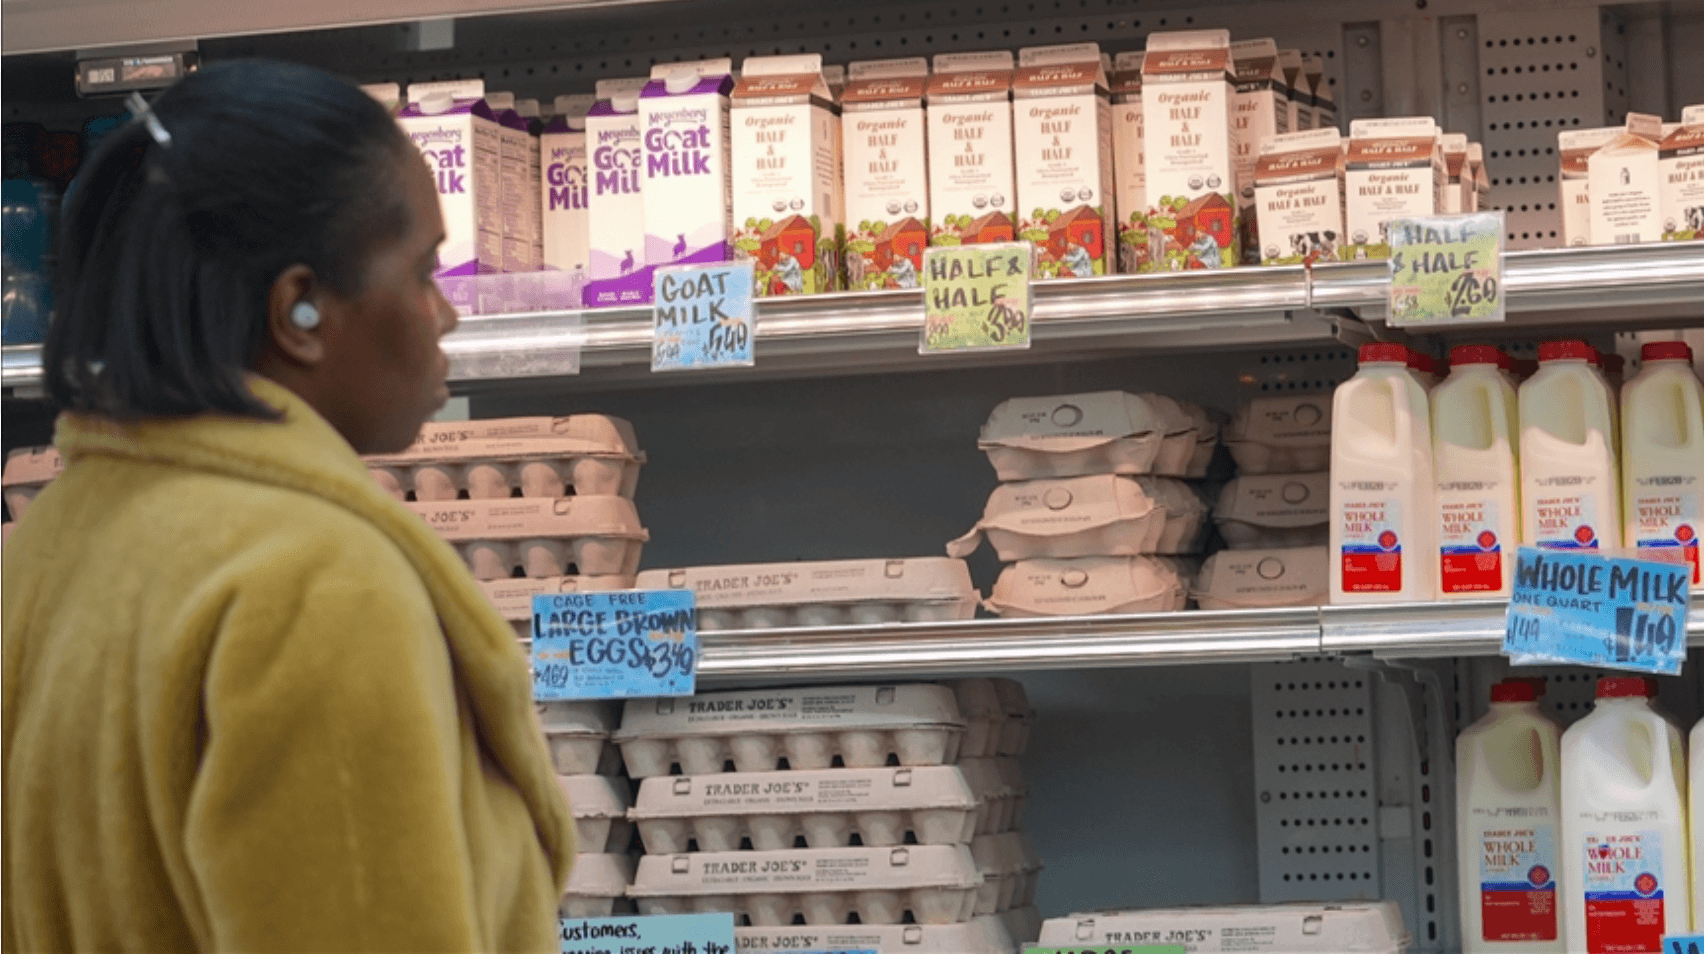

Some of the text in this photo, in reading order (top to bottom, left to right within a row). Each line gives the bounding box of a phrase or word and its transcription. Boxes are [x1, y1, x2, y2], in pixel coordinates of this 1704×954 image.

[1158, 89, 1211, 106] Organic
[943, 110, 994, 126] Organic
[1030, 103, 1081, 120] Organic
[1170, 106, 1202, 121] HALF
[745, 112, 796, 129] Organic
[858, 116, 908, 133] Organic
[1041, 120, 1072, 134] HALF
[1182, 121, 1190, 133] &
[645, 125, 710, 152] Goat
[756, 129, 786, 143] HALF
[868, 133, 898, 147] HALF
[954, 127, 985, 141] HALF
[1052, 134, 1061, 147] &
[1170, 133, 1202, 148] HALF
[879, 147, 887, 159] &
[965, 141, 974, 153] &
[1042, 147, 1073, 161] HALF
[593, 145, 641, 171] Goa
[647, 150, 711, 178] Milk
[756, 155, 787, 170] HALF
[954, 153, 985, 167] HALF
[547, 162, 588, 187] Go
[869, 160, 899, 174] HALF
[438, 170, 466, 194] lk
[596, 169, 641, 195] Mil
[1368, 172, 1410, 185] Organic
[1276, 185, 1316, 200] Organic
[1359, 182, 1421, 197] HALF & HALF
[549, 185, 588, 211] Mil
[1268, 194, 1328, 212] HALF & HALF
[1404, 224, 1477, 246] HALF
[930, 255, 1003, 281] HALF
[1412, 250, 1480, 274] HALF
[661, 270, 731, 303] GOAT
[932, 283, 1008, 310] HALF
[656, 297, 730, 328] MILK
[1343, 511, 1387, 521] WHOLE
[1441, 511, 1485, 522] WHOLE
[1537, 506, 1582, 518] WHOLE
[1639, 506, 1682, 516] WHOLE
[1343, 522, 1373, 533] MILK
[1442, 522, 1472, 533] MILK
[1538, 517, 1568, 529] MILK
[1639, 516, 1668, 527] MILK
[697, 574, 792, 592] TRADER JOE'S
[1517, 554, 1687, 605] WHOLE MILK
[553, 593, 595, 608] CAGE
[608, 592, 646, 606] FREE
[1513, 590, 1602, 614] ONE QUART
[534, 607, 694, 639] LARGE BROWN
[569, 636, 648, 669] EGGS
[689, 699, 743, 714] TRADER
[747, 697, 788, 711] JOE'S
[705, 783, 761, 797] TRADER
[764, 781, 805, 795] JOE'S
[1483, 841, 1535, 853] WHOLE
[703, 861, 758, 875] TRADER
[761, 859, 802, 873] JOE'S
[1485, 854, 1520, 867] MILK
[1587, 861, 1626, 874] MILK
[559, 919, 642, 942] ustomers,
[1105, 931, 1207, 942] TRADER JOE'S
[772, 935, 812, 949] JOE'S
